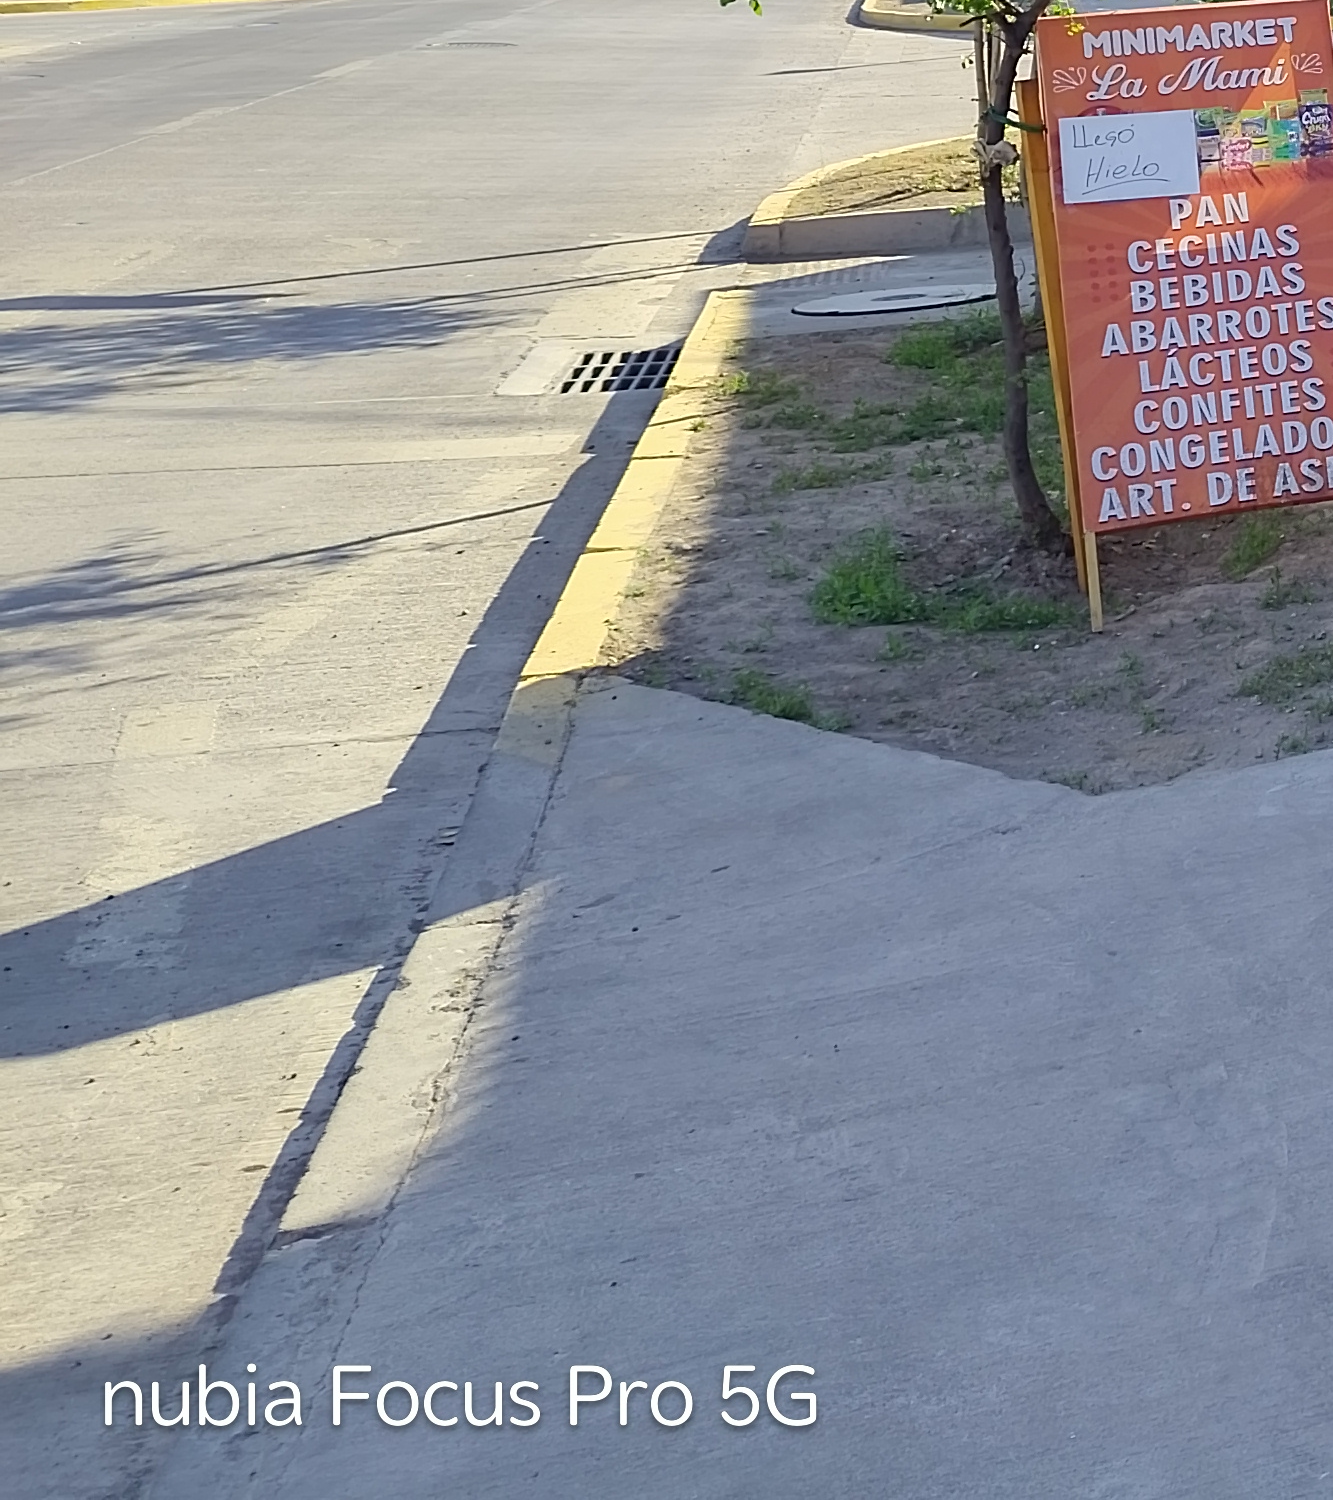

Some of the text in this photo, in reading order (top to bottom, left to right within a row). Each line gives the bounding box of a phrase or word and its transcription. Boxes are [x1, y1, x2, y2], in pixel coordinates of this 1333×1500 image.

[1082, 17, 1297, 59] MINIMARKET
[1086, 55, 1288, 101] La Mami
[1169, 192, 1250, 230] PAN
[1127, 224, 1300, 274] CECINAS
[1130, 263, 1306, 314] BEBIDAS
[1139, 340, 1313, 393] LÁCTEOS
[1134, 378, 1327, 435] CONFITES
[1098, 478, 1192, 523] ART.
[1207, 467, 1258, 507] DE
